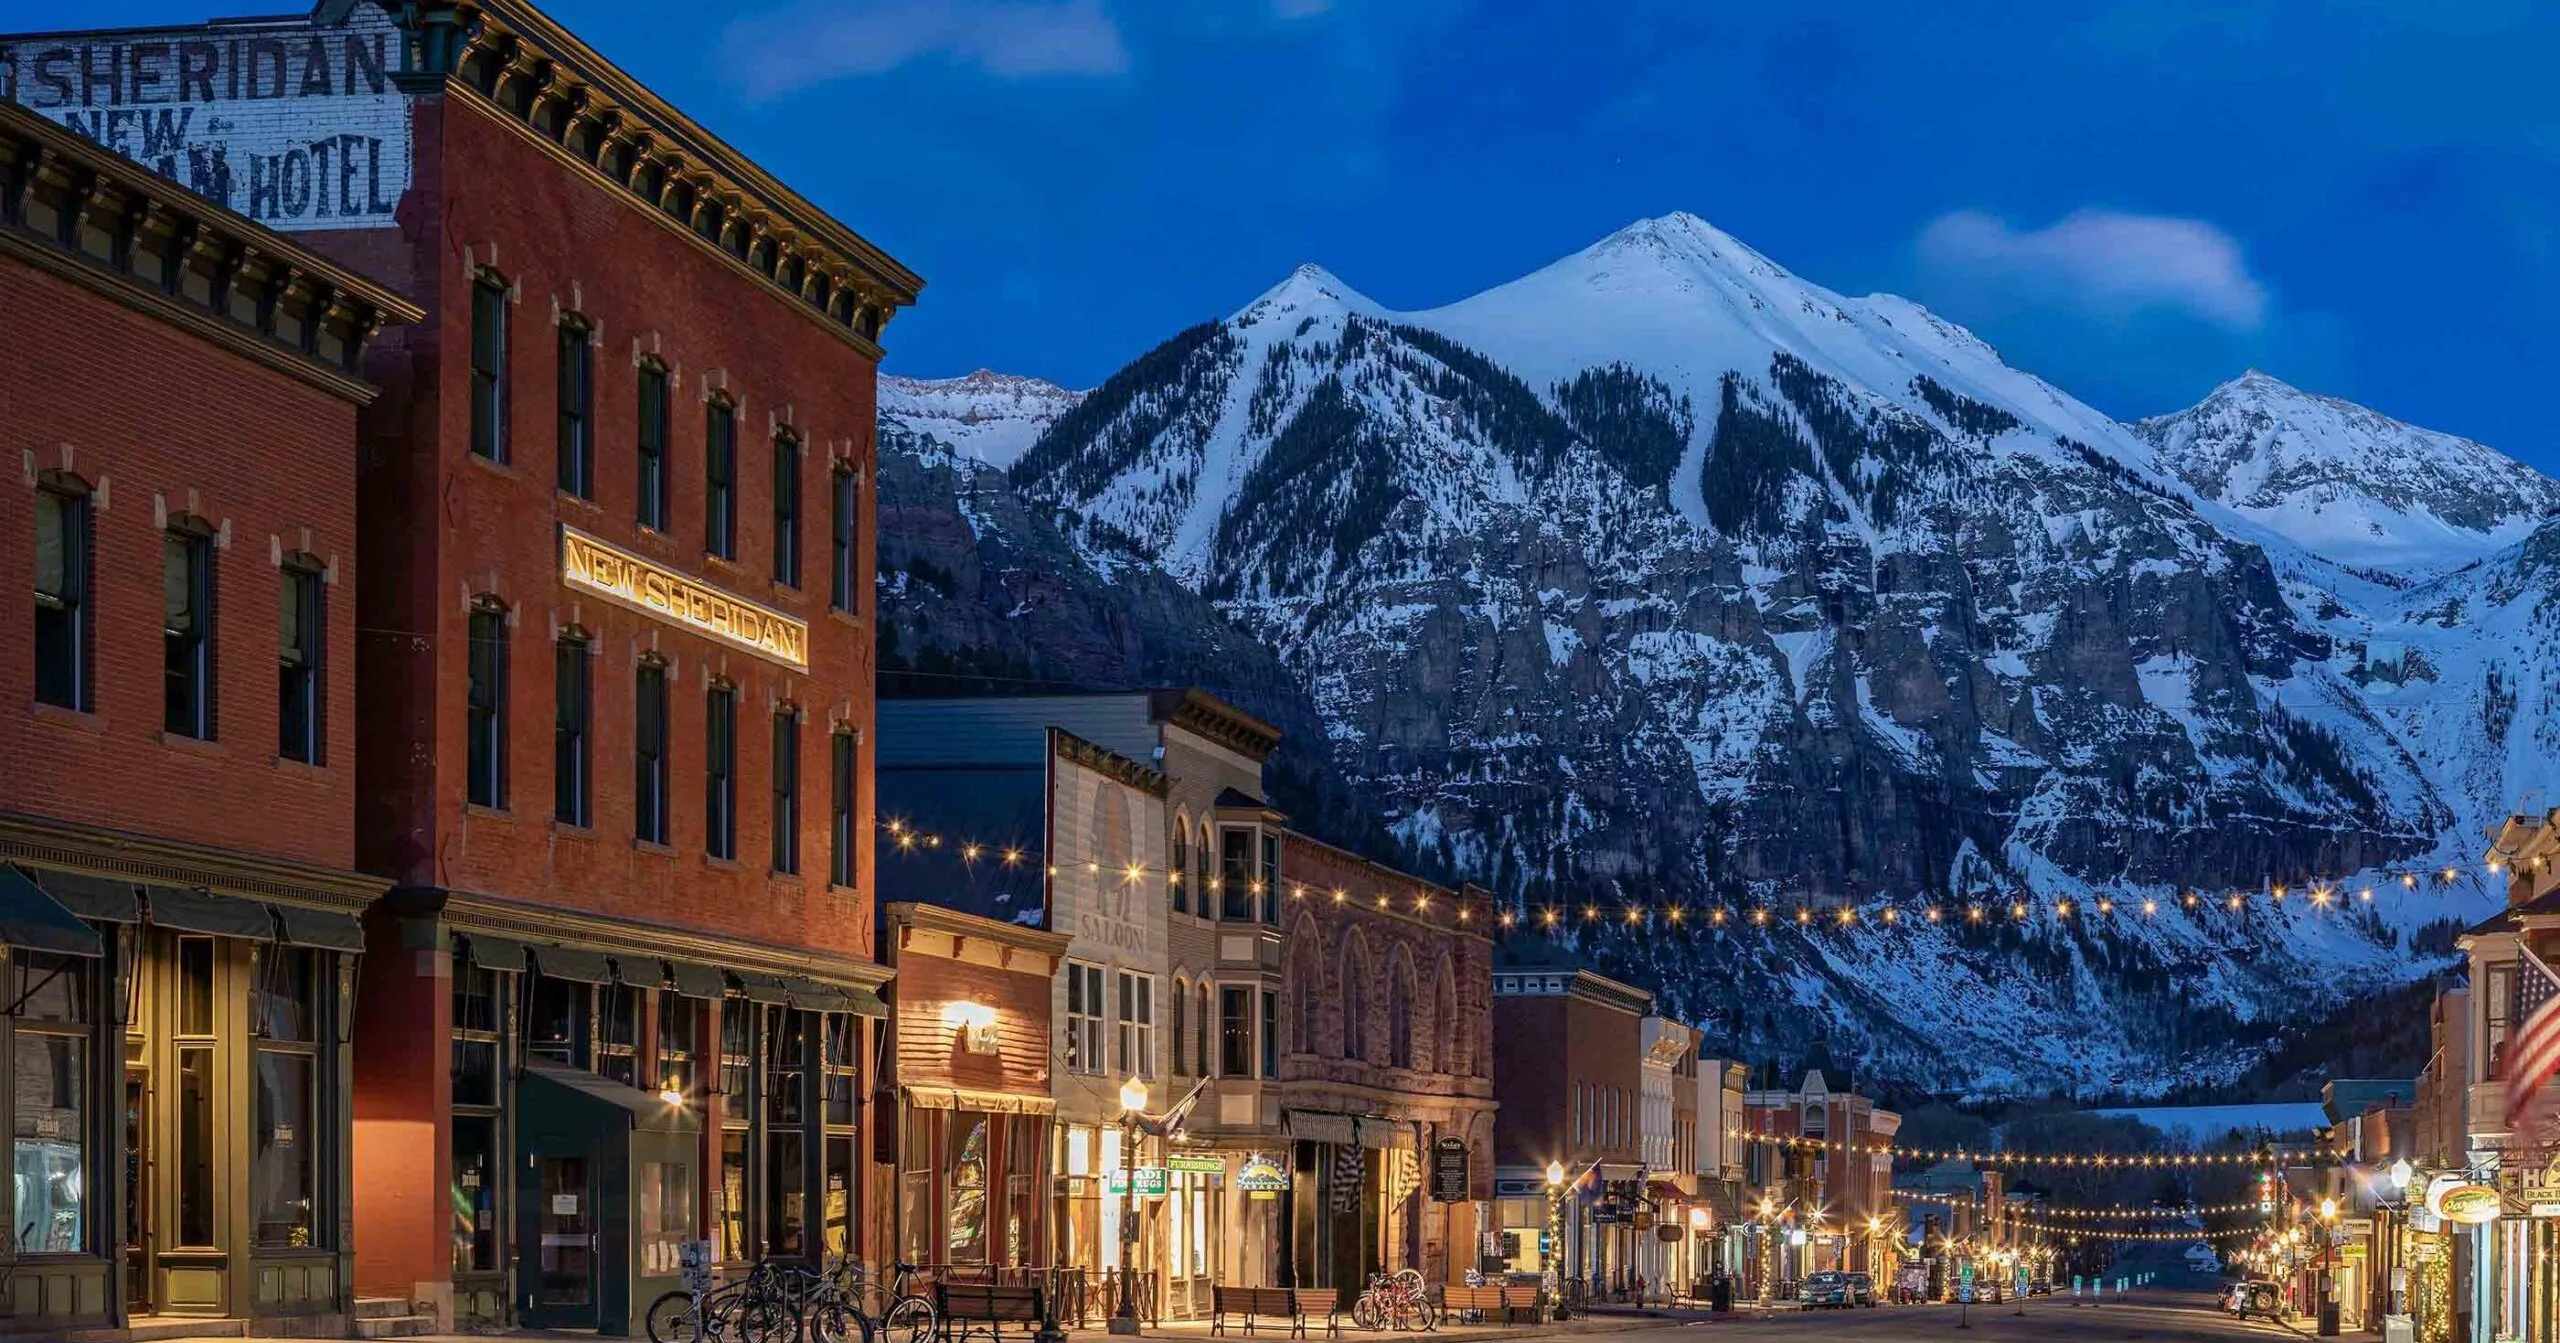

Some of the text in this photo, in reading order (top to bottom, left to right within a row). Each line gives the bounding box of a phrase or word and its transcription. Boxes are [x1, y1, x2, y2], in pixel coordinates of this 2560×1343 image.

[34, 33, 386, 108] SHERIDAN
[65, 107, 196, 154] NEW
[249, 133, 393, 220] HOTEL
[567, 539, 797, 659] NEW SHERIDAN
[1081, 913, 1144, 953] SALOON
[2526, 1190, 2553, 1199] BLACK
